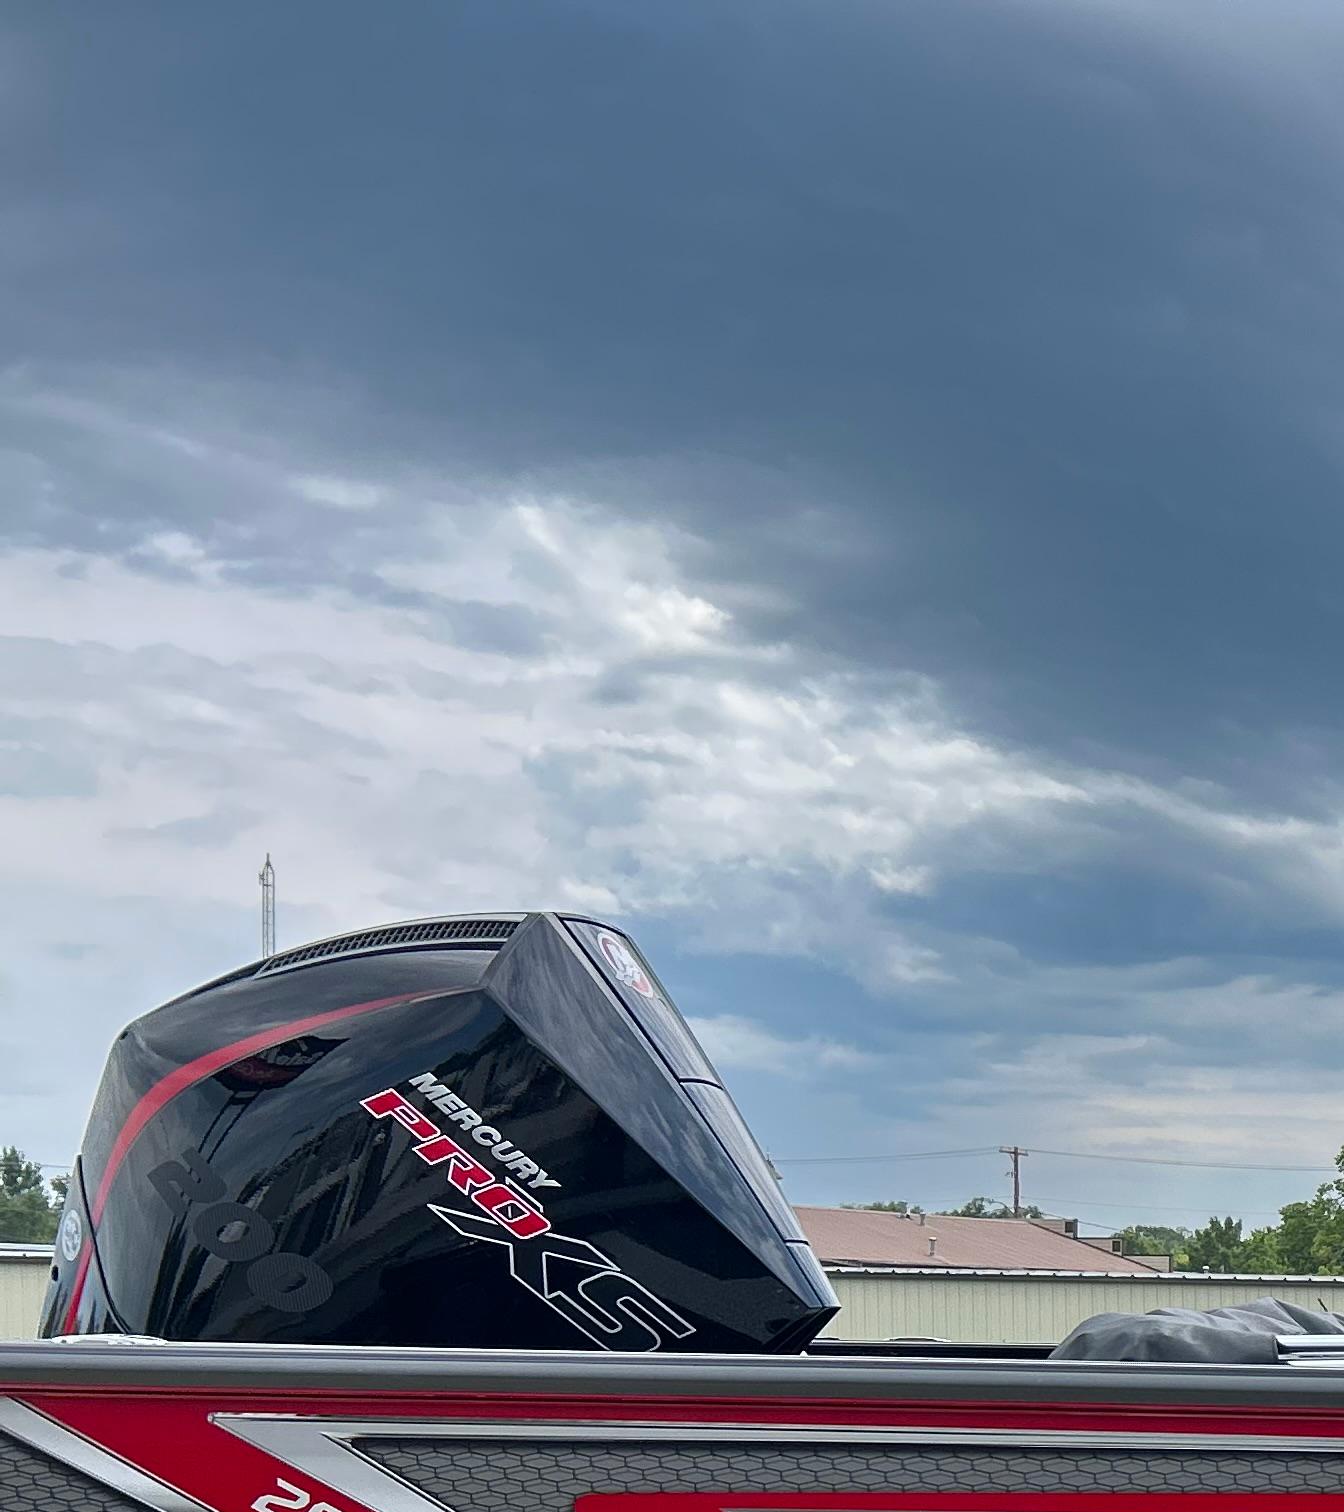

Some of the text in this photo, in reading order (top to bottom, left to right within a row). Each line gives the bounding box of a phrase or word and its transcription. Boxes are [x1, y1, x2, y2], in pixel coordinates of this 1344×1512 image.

[359, 1087, 552, 1240] PRO
[409, 1071, 562, 1190] MERCURY
[147, 1146, 334, 1313] 200
[427, 1177, 697, 1353] XS
